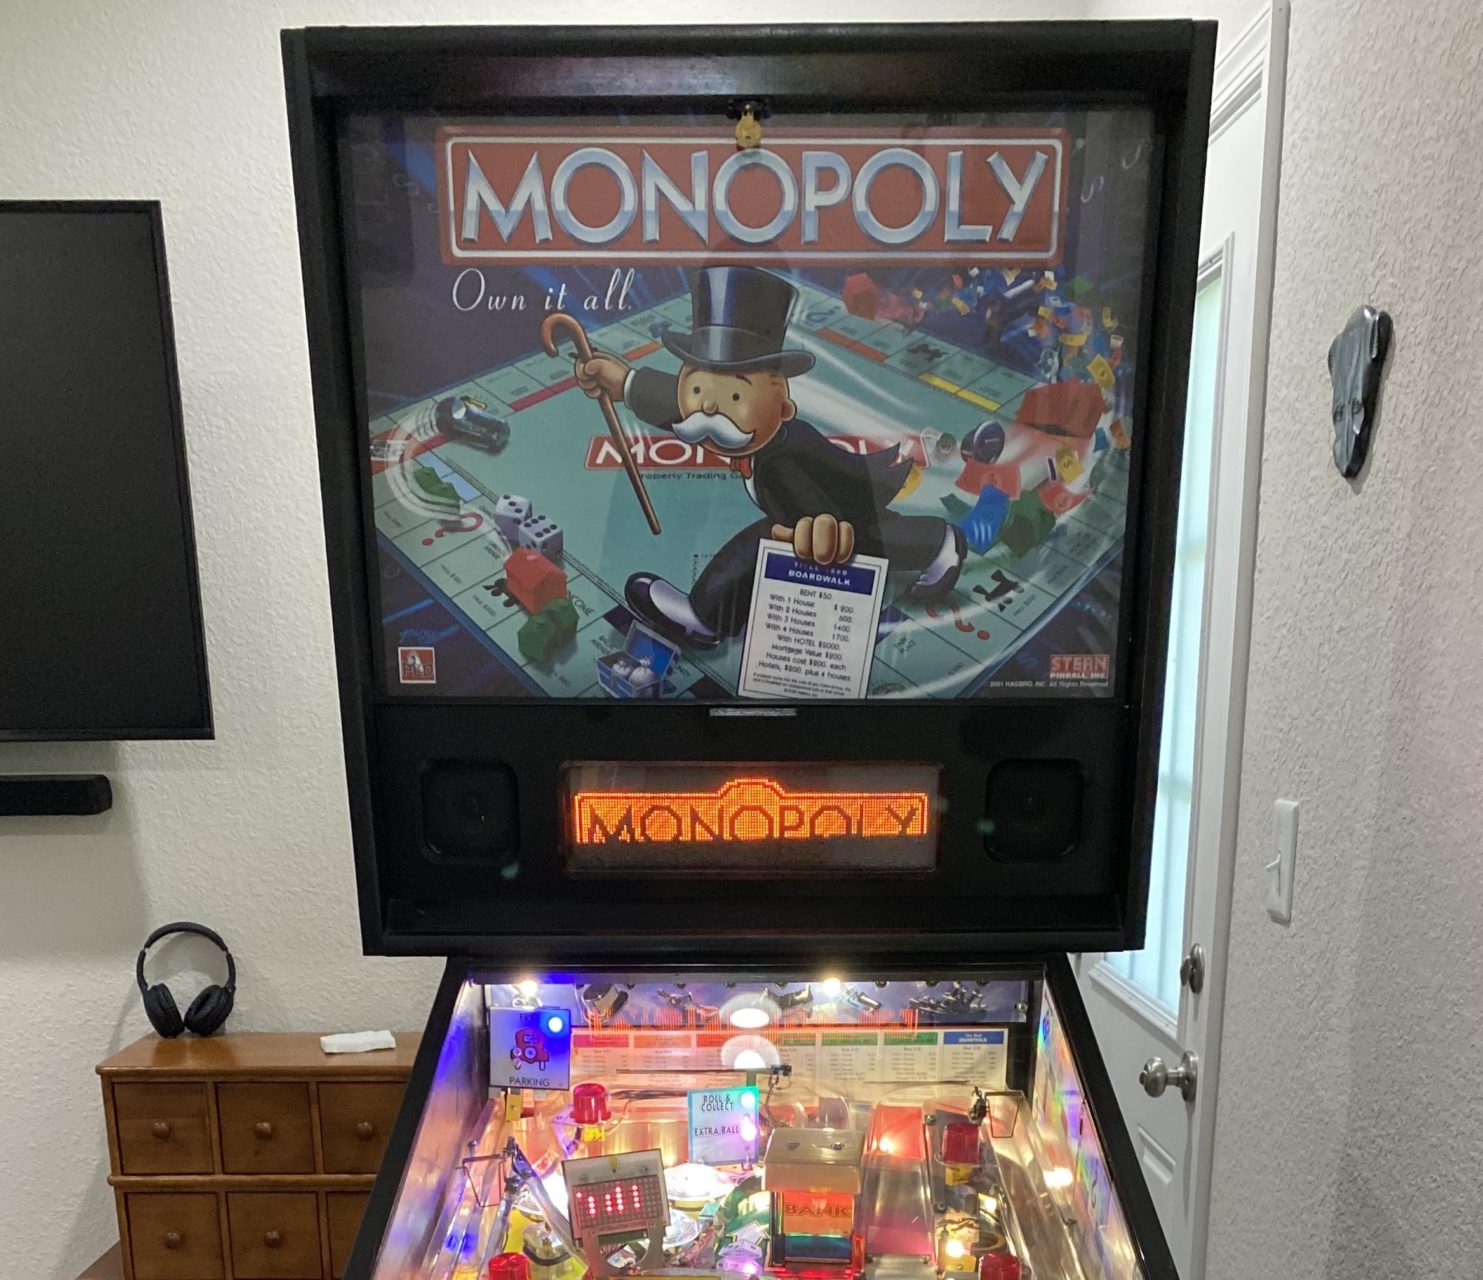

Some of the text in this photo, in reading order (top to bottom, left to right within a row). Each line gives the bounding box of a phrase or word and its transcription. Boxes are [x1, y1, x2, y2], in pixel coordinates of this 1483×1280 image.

[461, 148, 1049, 245] MONOPOLY
[452, 268, 527, 311] Own
[544, 279, 569, 310] it
[639, 472, 682, 482] roperty
[788, 570, 851, 586] BOARDWALK
[770, 593, 785, 602] With
[793, 597, 815, 608] House
[800, 589, 817, 599] RENT
[768, 603, 784, 612] With
[792, 606, 817, 618] Houses
[767, 613, 782, 622] With
[791, 616, 815, 627] Houses
[765, 622, 781, 631] With
[789, 626, 814, 637] Houses
[777, 634, 793, 643] With
[794, 637, 815, 647] HOTEL
[771, 644, 803, 656] Mortgage
[805, 649, 822, 658] Value
[766, 652, 791, 663] Houses
[792, 657, 807, 665] cost
[830, 663, 847, 671] each
[1051, 656, 1107, 672] STERN
[804, 668, 819, 678] plus
[827, 671, 851, 682] houses
[587, 804, 920, 843] MONOPOLY
[509, 1076, 550, 1087] PARKING
[703, 1095, 723, 1103] ROLL
[702, 1102, 734, 1112] COLLECT
[694, 1126, 739, 1136] EXTRA BALL
[785, 1205, 851, 1218] BANK
